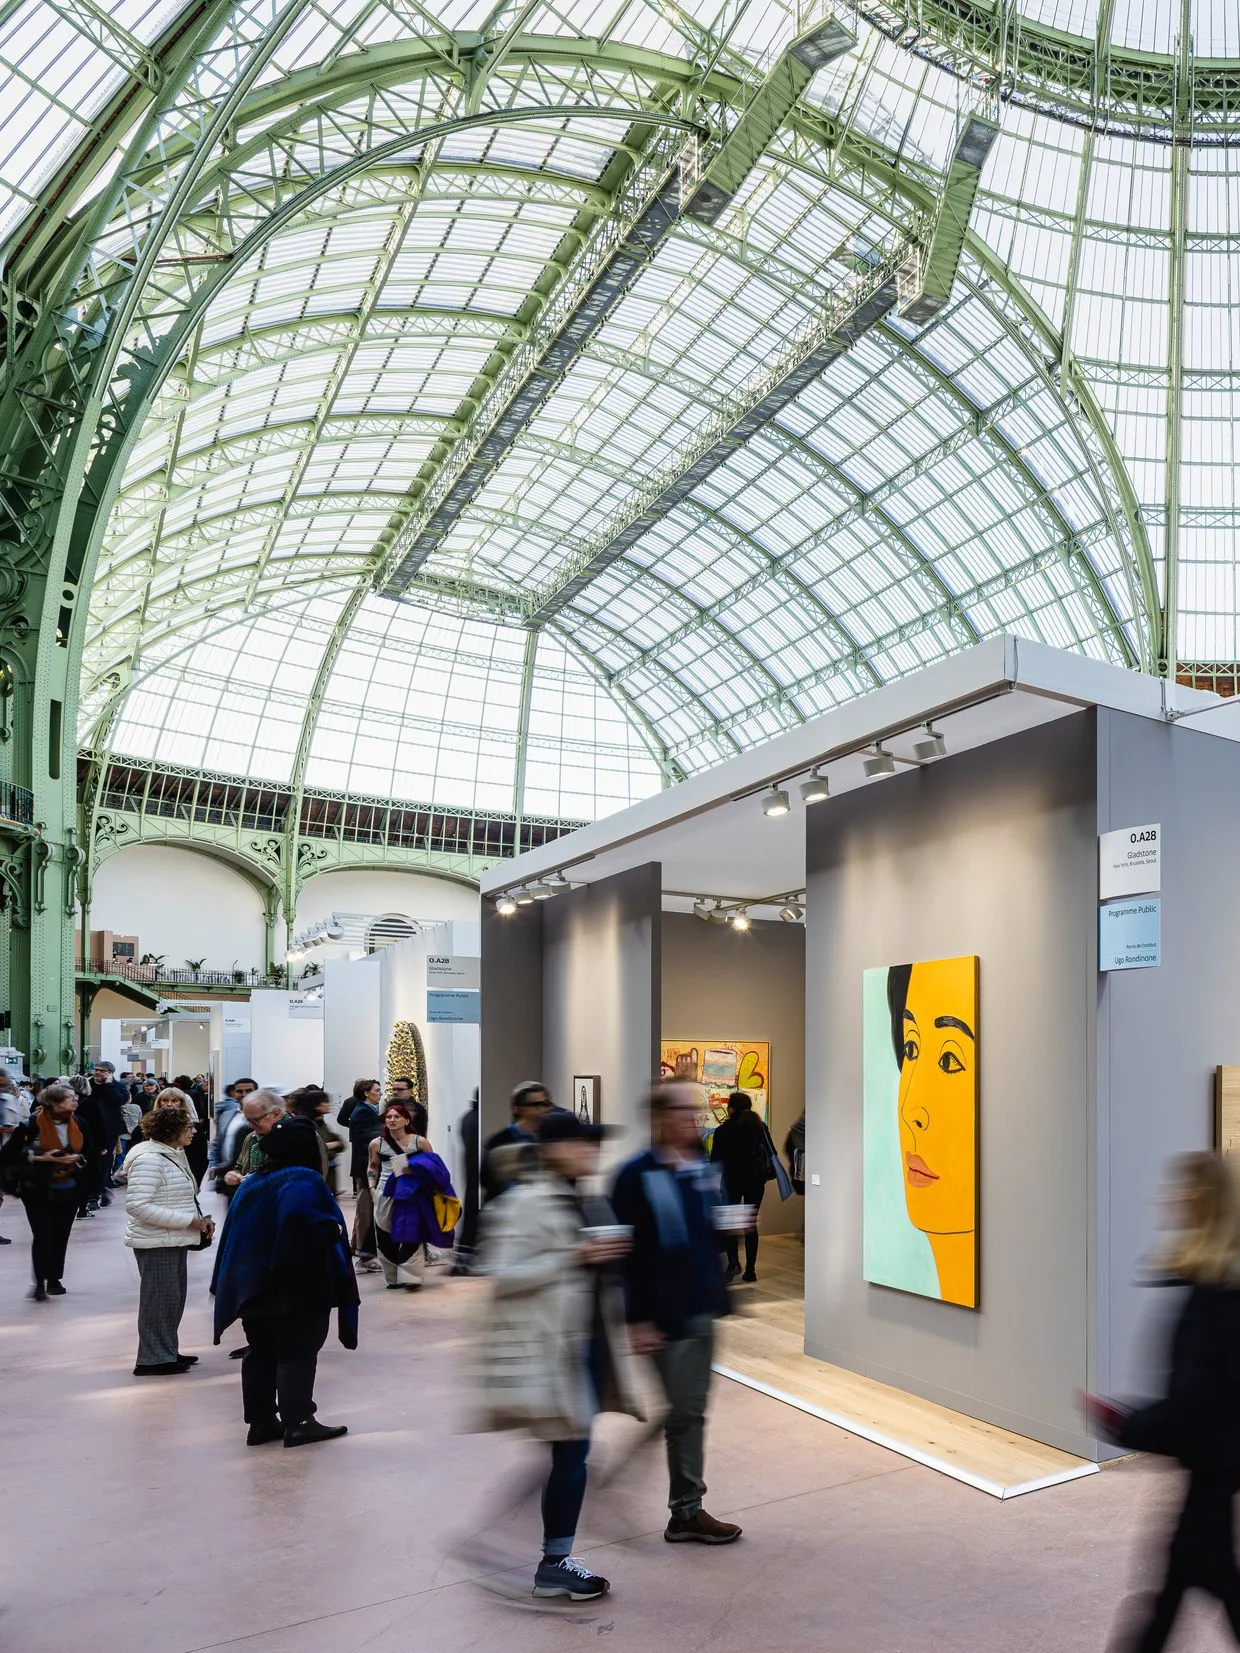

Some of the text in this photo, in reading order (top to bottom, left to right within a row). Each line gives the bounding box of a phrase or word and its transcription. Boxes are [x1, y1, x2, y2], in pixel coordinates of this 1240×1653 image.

[1130, 830, 1156, 844] 0.A28
[1128, 849, 1156, 860] Gladstone
[1109, 905, 1156, 918] Programme Public
[1115, 955, 1156, 965] Ugo Rondinone
